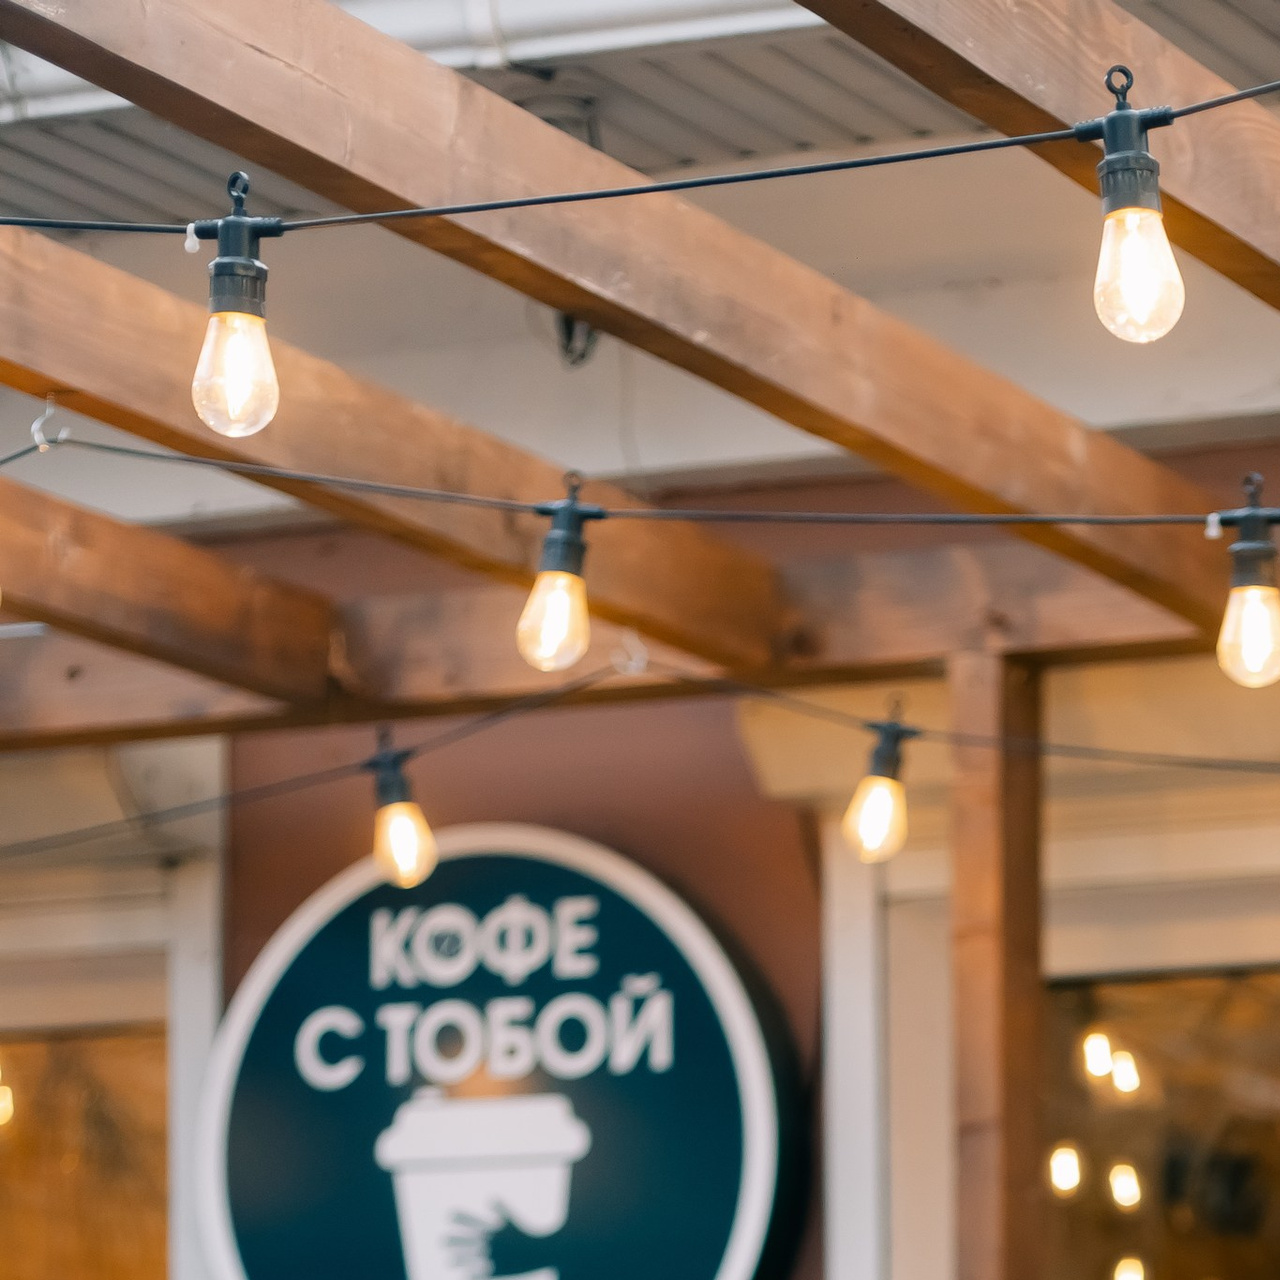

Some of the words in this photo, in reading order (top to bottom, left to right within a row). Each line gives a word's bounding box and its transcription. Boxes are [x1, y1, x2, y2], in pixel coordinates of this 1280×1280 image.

[369, 895, 598, 988] КОФЕ
[294, 1006, 364, 1090] С
[377, 974, 674, 1086] ТОБОЙ
